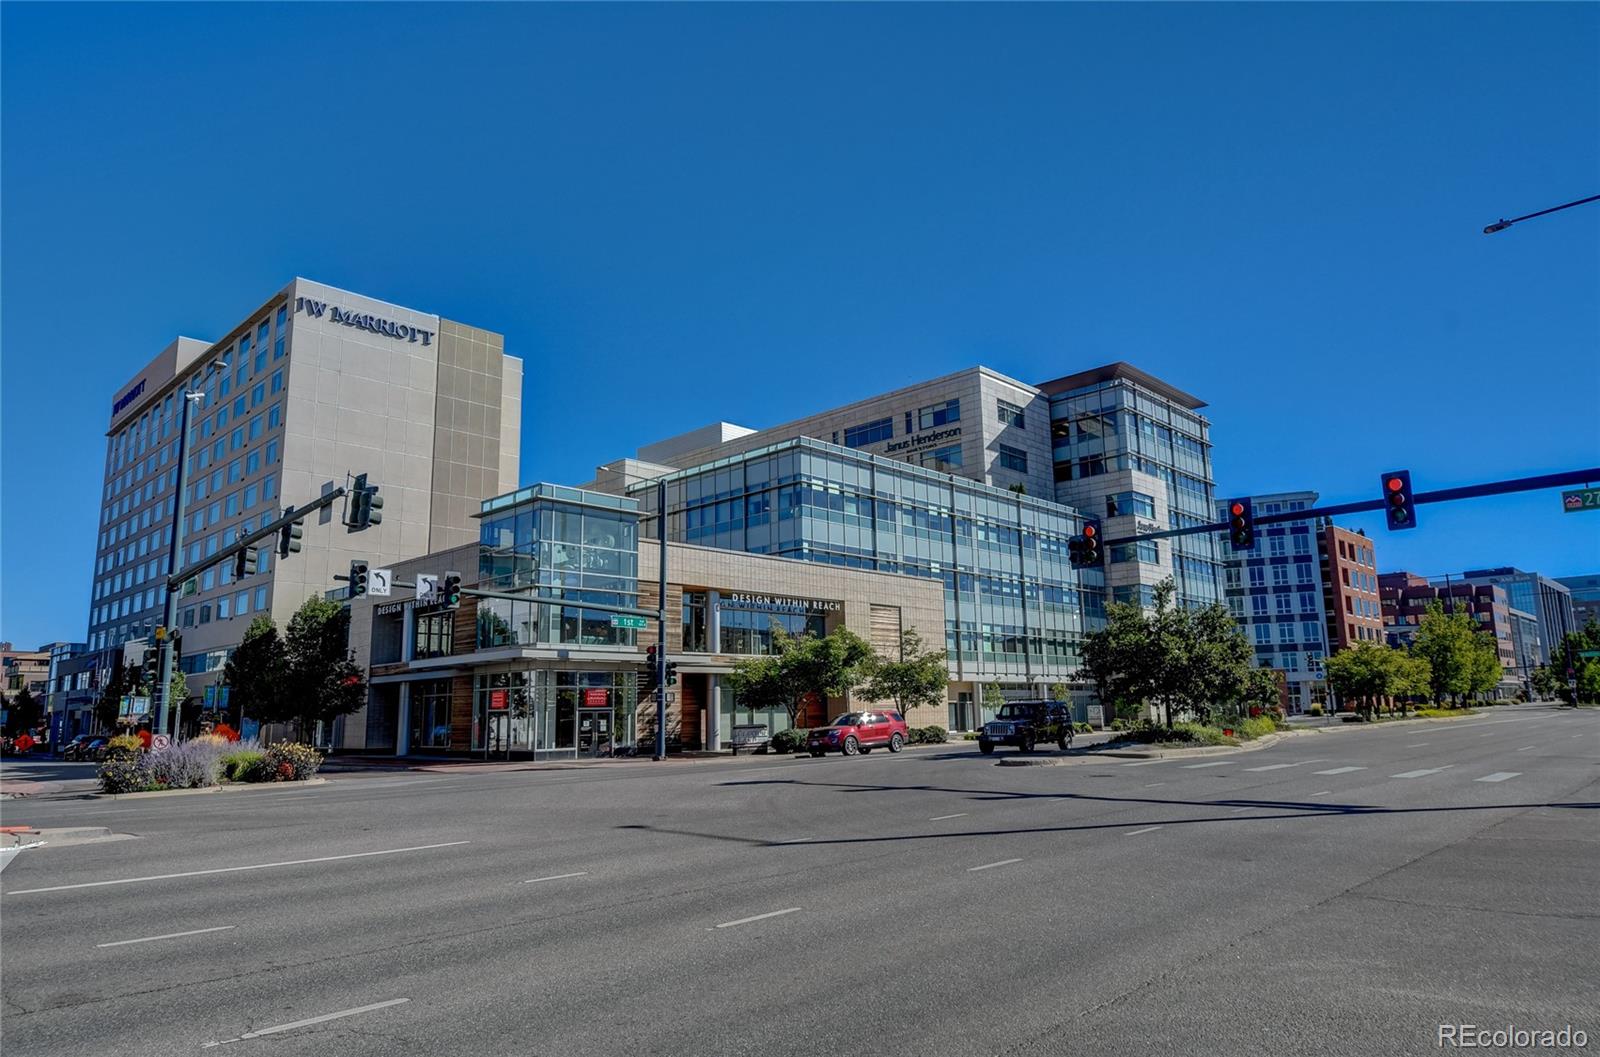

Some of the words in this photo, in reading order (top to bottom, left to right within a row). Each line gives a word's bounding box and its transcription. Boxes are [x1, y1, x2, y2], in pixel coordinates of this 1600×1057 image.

[295, 297, 326, 319] JW
[329, 307, 435, 346] MARRIOTT
[884, 439, 911, 453] Janus
[911, 427, 961, 447] Henderson
[377, 602, 402, 615] DESIGN
[732, 593, 771, 605] DESIGN
[774, 597, 810, 609] WITHIN
[813, 601, 841, 611] REACH
[623, 618, 634, 626] 1st
